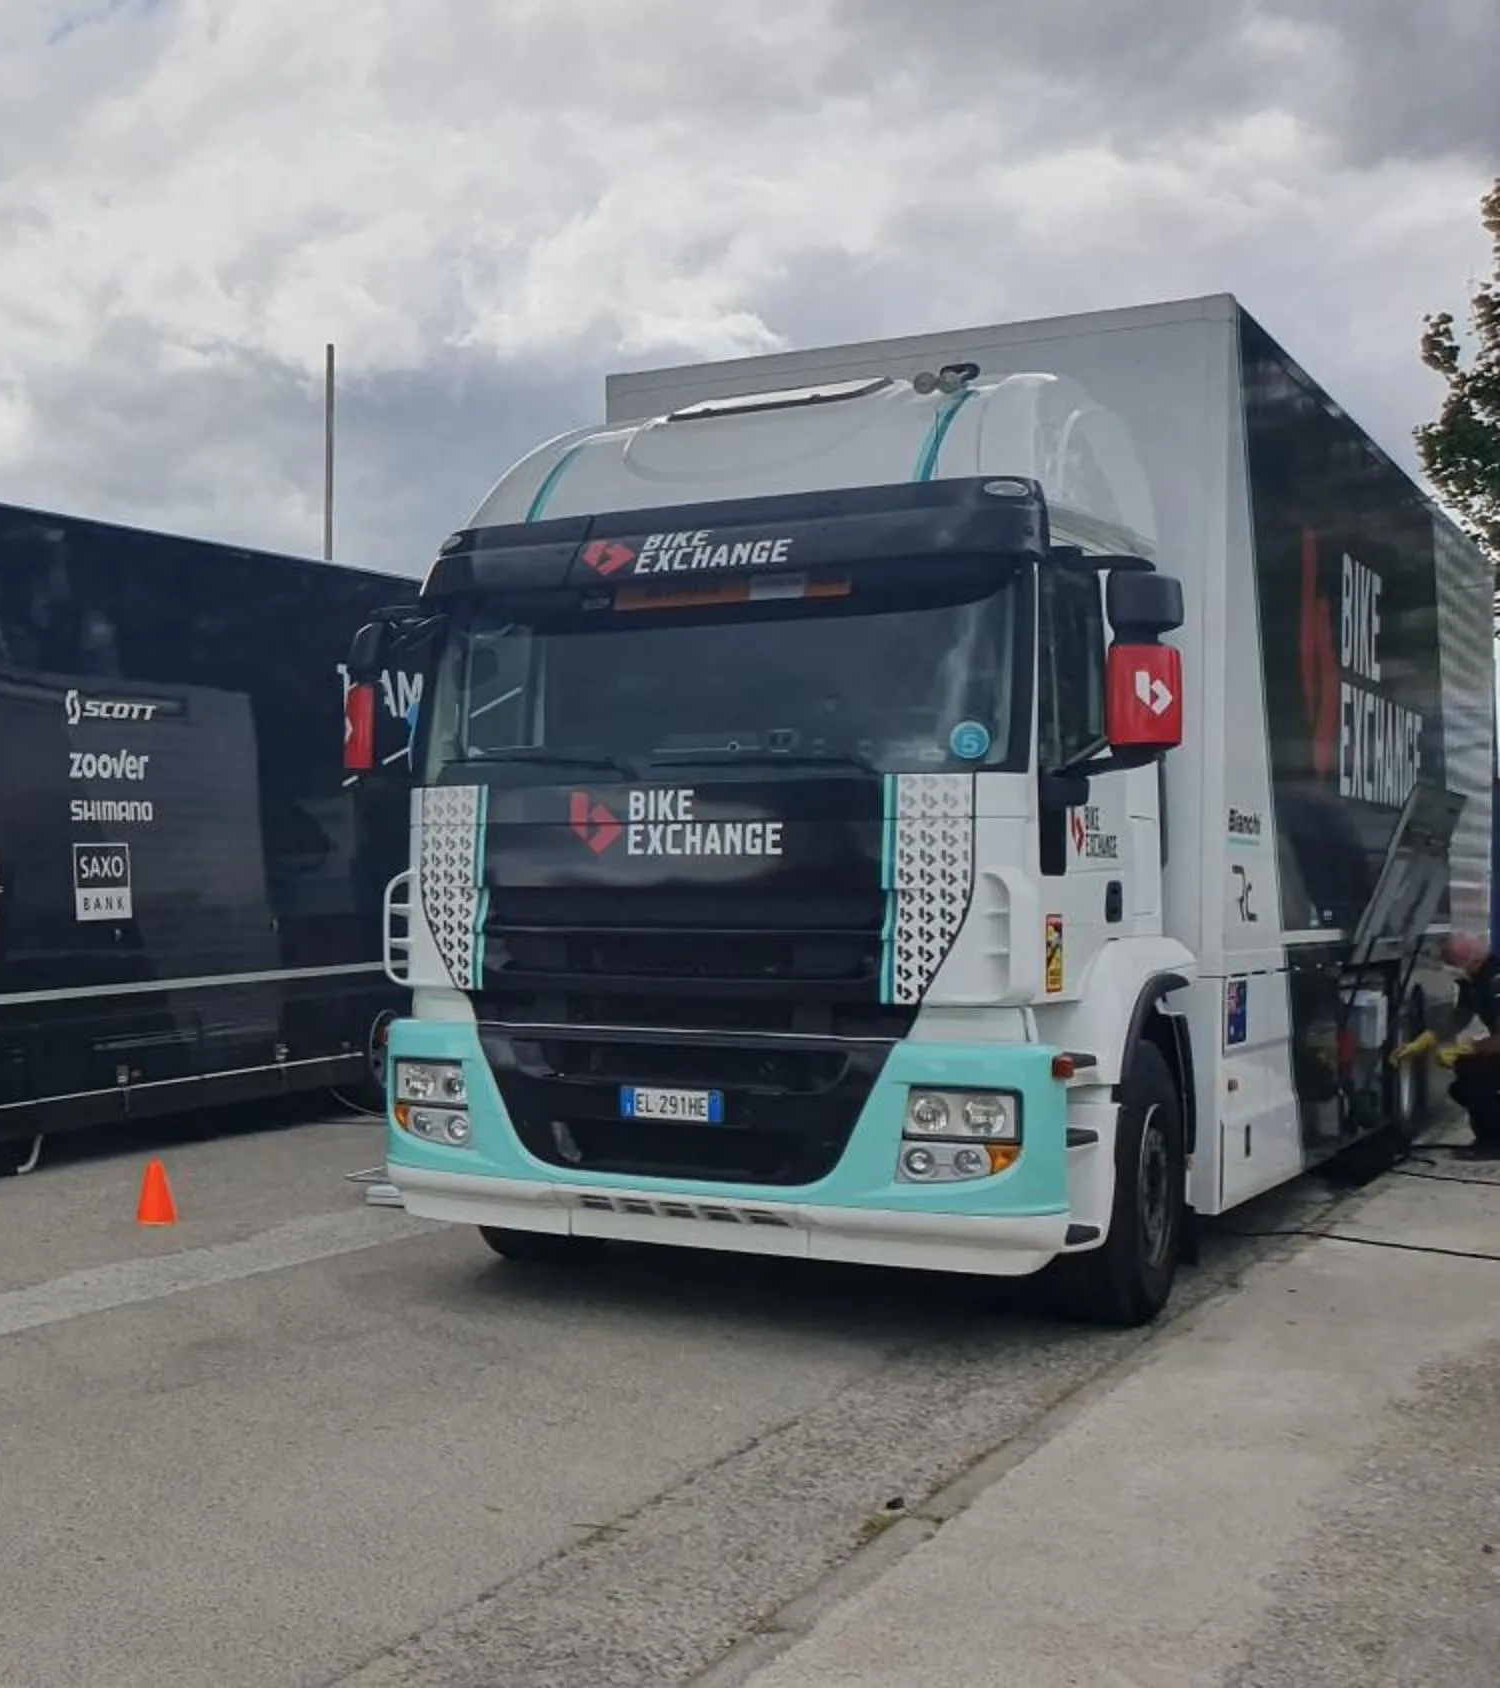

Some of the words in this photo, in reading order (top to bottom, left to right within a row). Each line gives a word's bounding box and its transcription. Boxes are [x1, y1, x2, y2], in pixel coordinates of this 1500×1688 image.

[642, 529, 715, 551] BIKE
[633, 538, 794, 575] EXCHANGE
[1341, 552, 1383, 683] BIKE
[82, 700, 157, 720] SCOTT
[70, 800, 154, 822] SHIMANO
[627, 788, 695, 821] BIKE
[627, 822, 784, 855] EXCHANGE
[79, 856, 125, 879] SAXO
[82, 896, 125, 912] BANK
